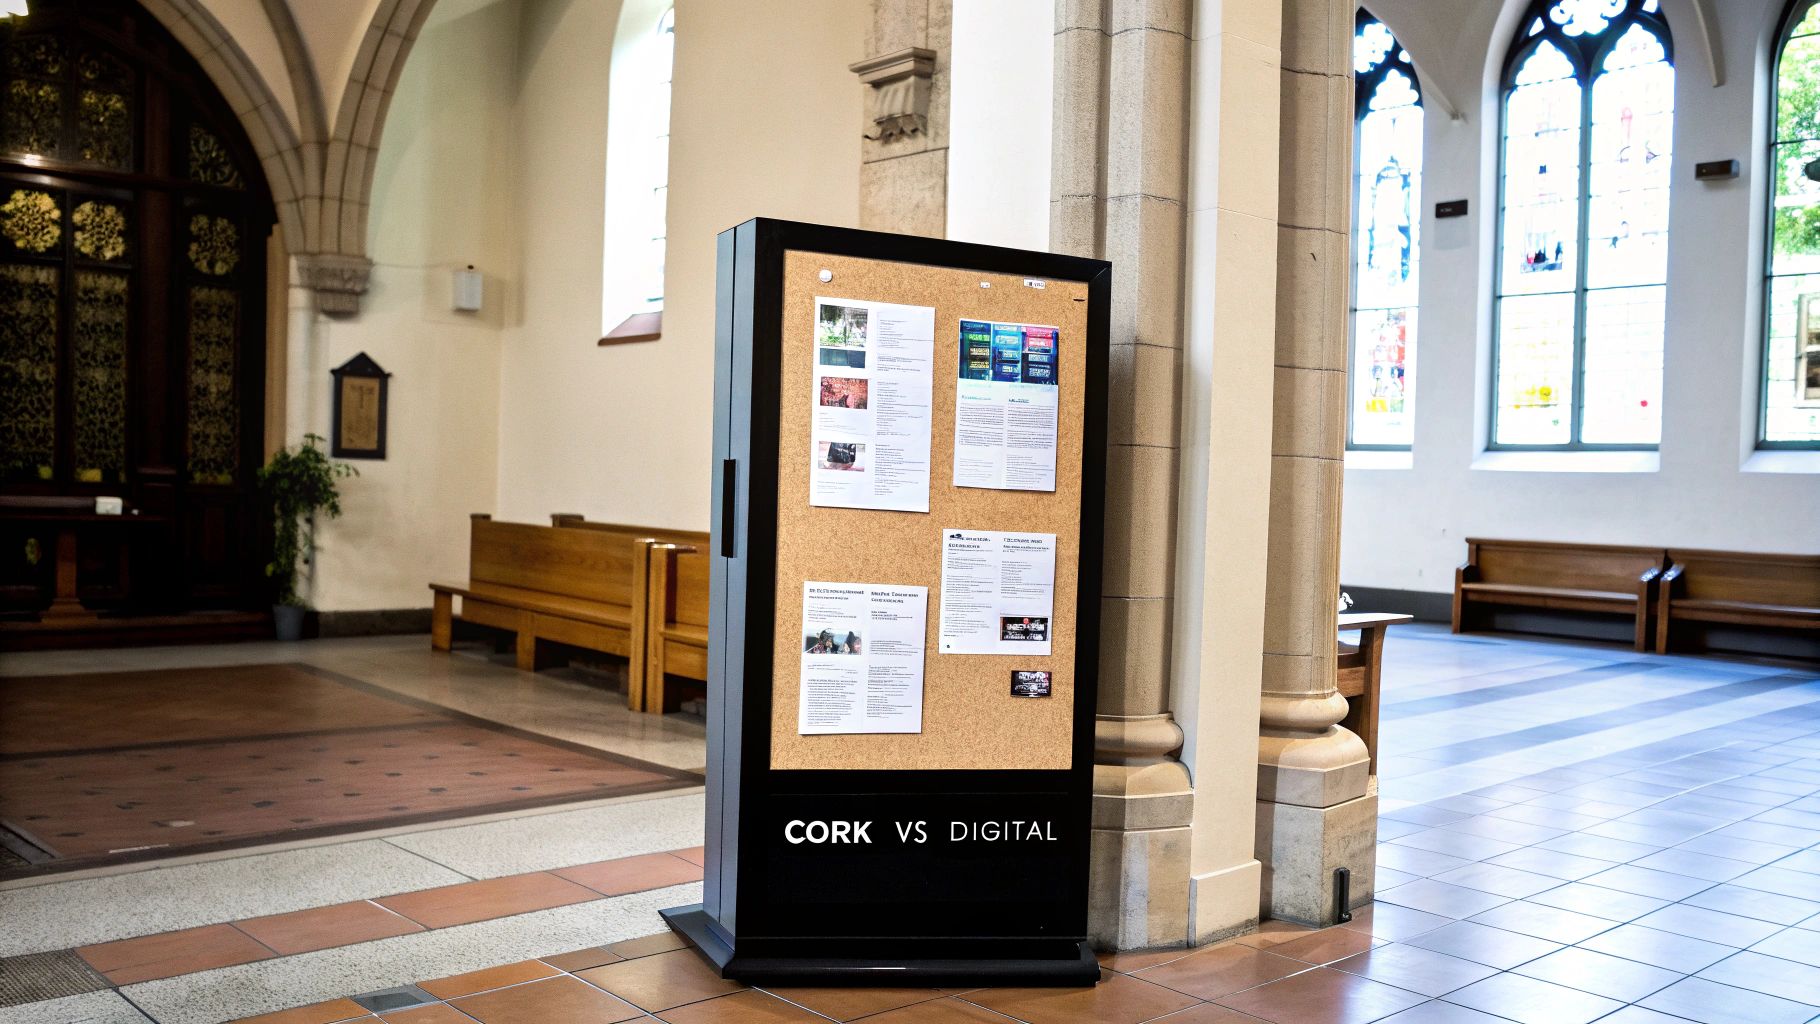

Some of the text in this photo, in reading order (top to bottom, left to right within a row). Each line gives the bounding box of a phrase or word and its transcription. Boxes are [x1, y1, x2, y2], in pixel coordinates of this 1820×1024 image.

[785, 820, 1058, 844] CORK VS DIGITAL
